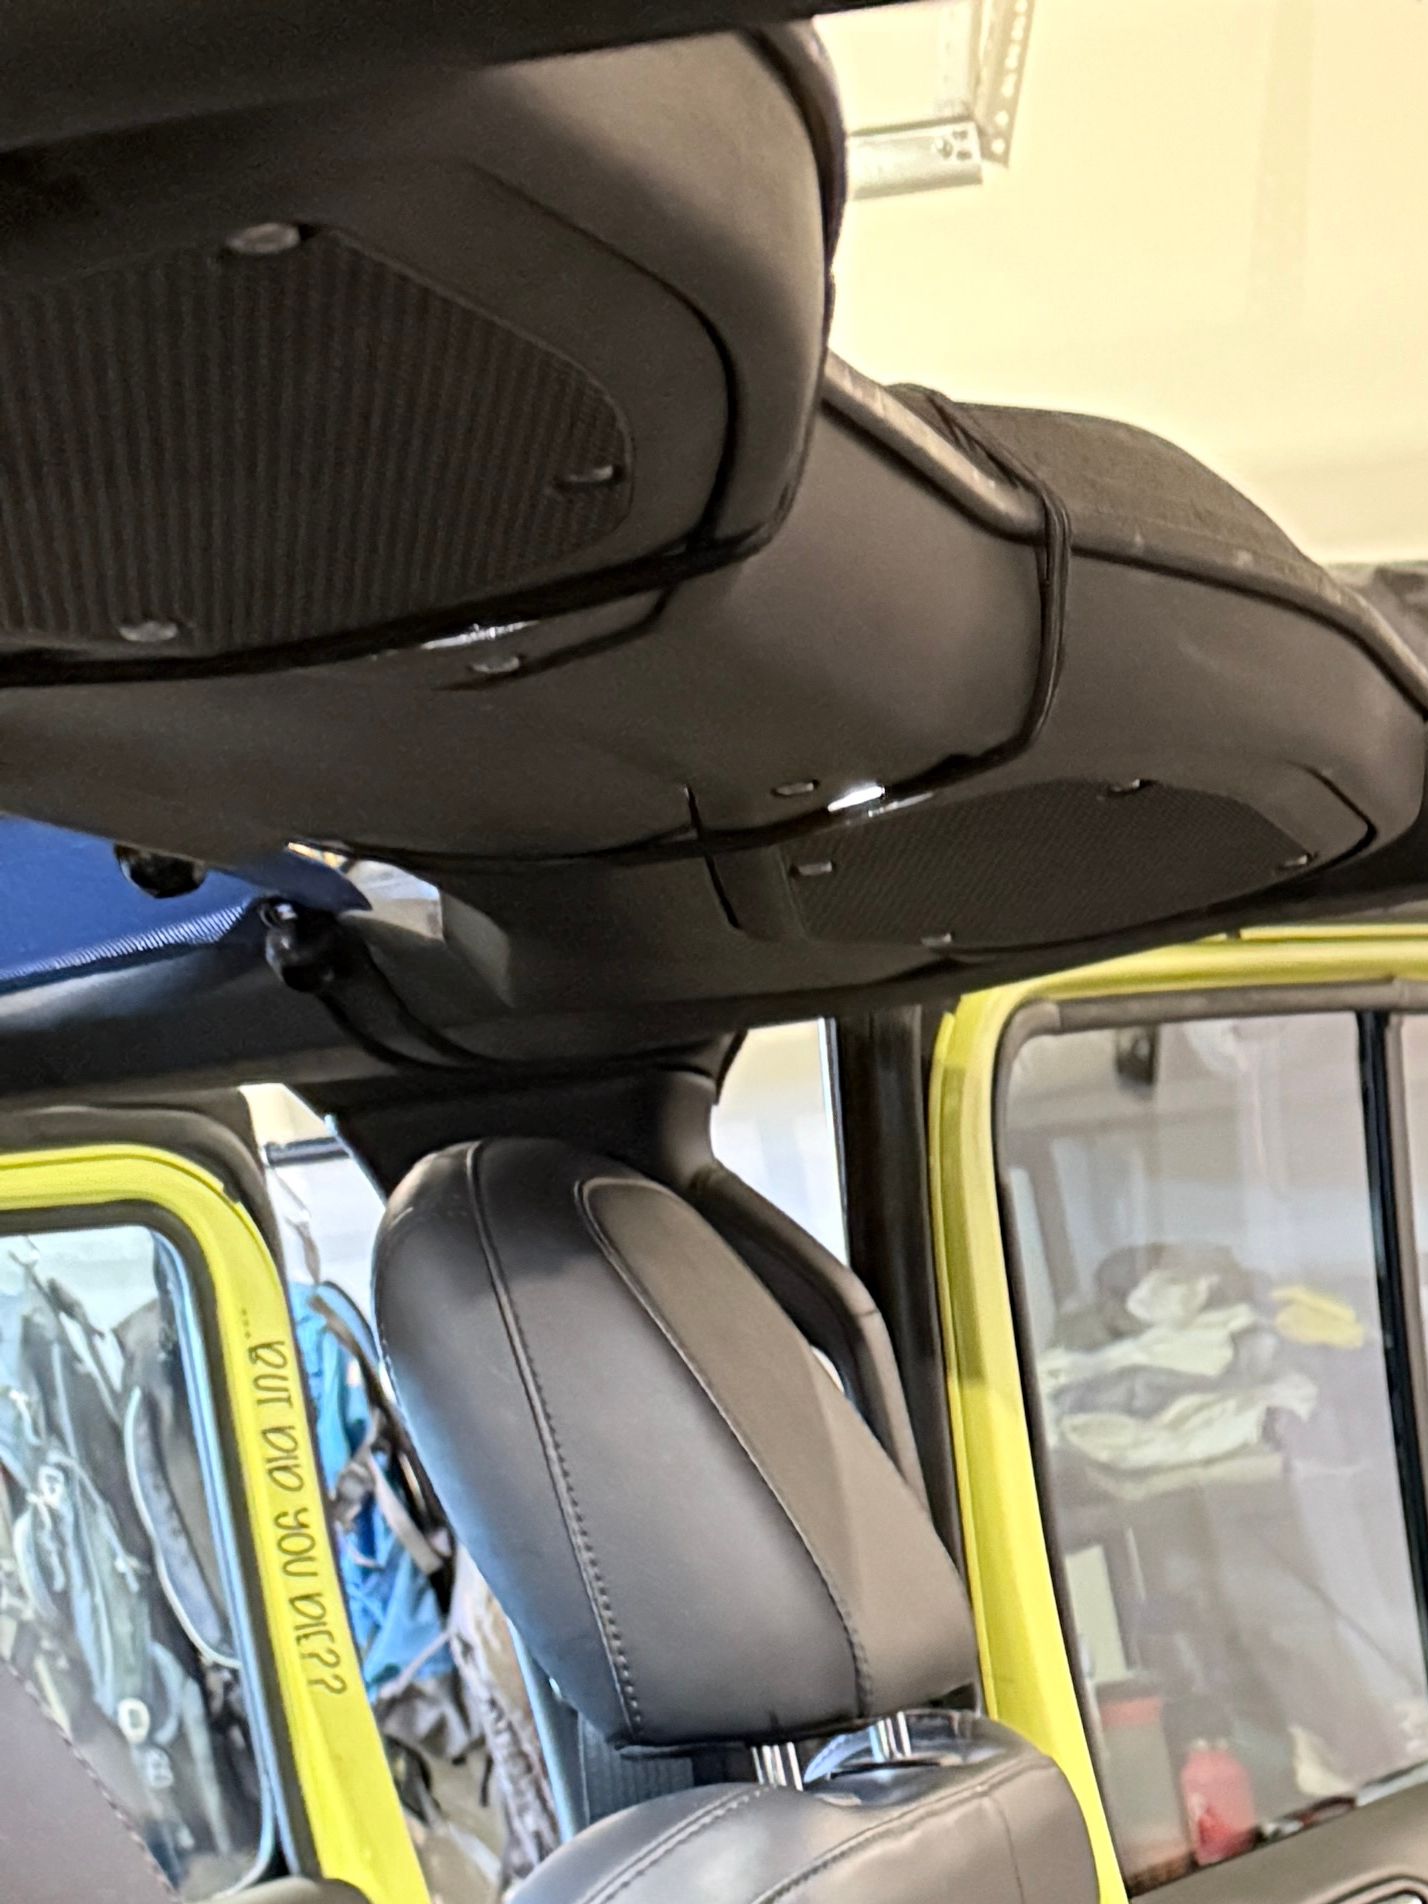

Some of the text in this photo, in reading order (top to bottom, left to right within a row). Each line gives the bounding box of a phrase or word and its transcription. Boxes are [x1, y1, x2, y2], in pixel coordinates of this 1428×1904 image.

[260, 1426, 305, 1491] DID
[274, 1508, 318, 1577] YOU
[289, 1592, 348, 1695] DIE??
